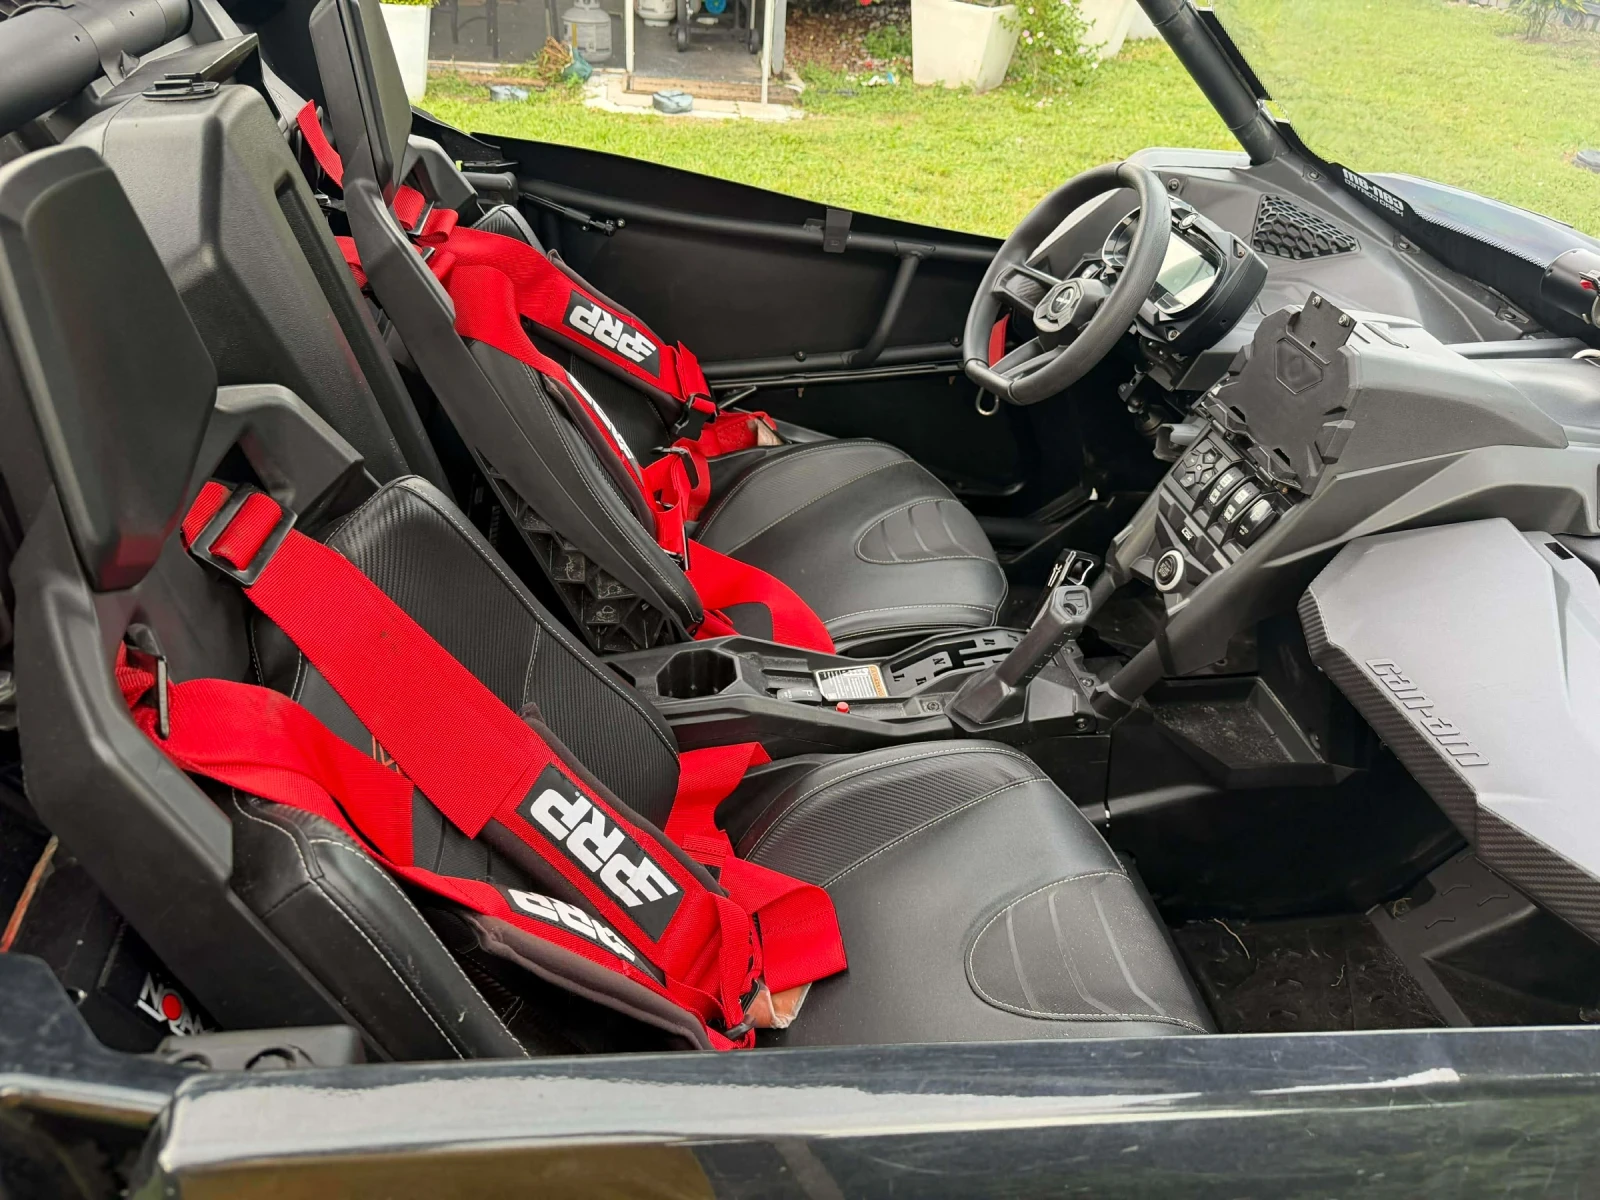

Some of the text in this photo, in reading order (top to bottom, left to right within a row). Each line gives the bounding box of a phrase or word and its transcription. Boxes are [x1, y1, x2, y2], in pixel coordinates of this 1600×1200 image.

[569, 303, 657, 363] PRP
[1365, 658, 1490, 767] can-am
[530, 788, 679, 908] PRP
